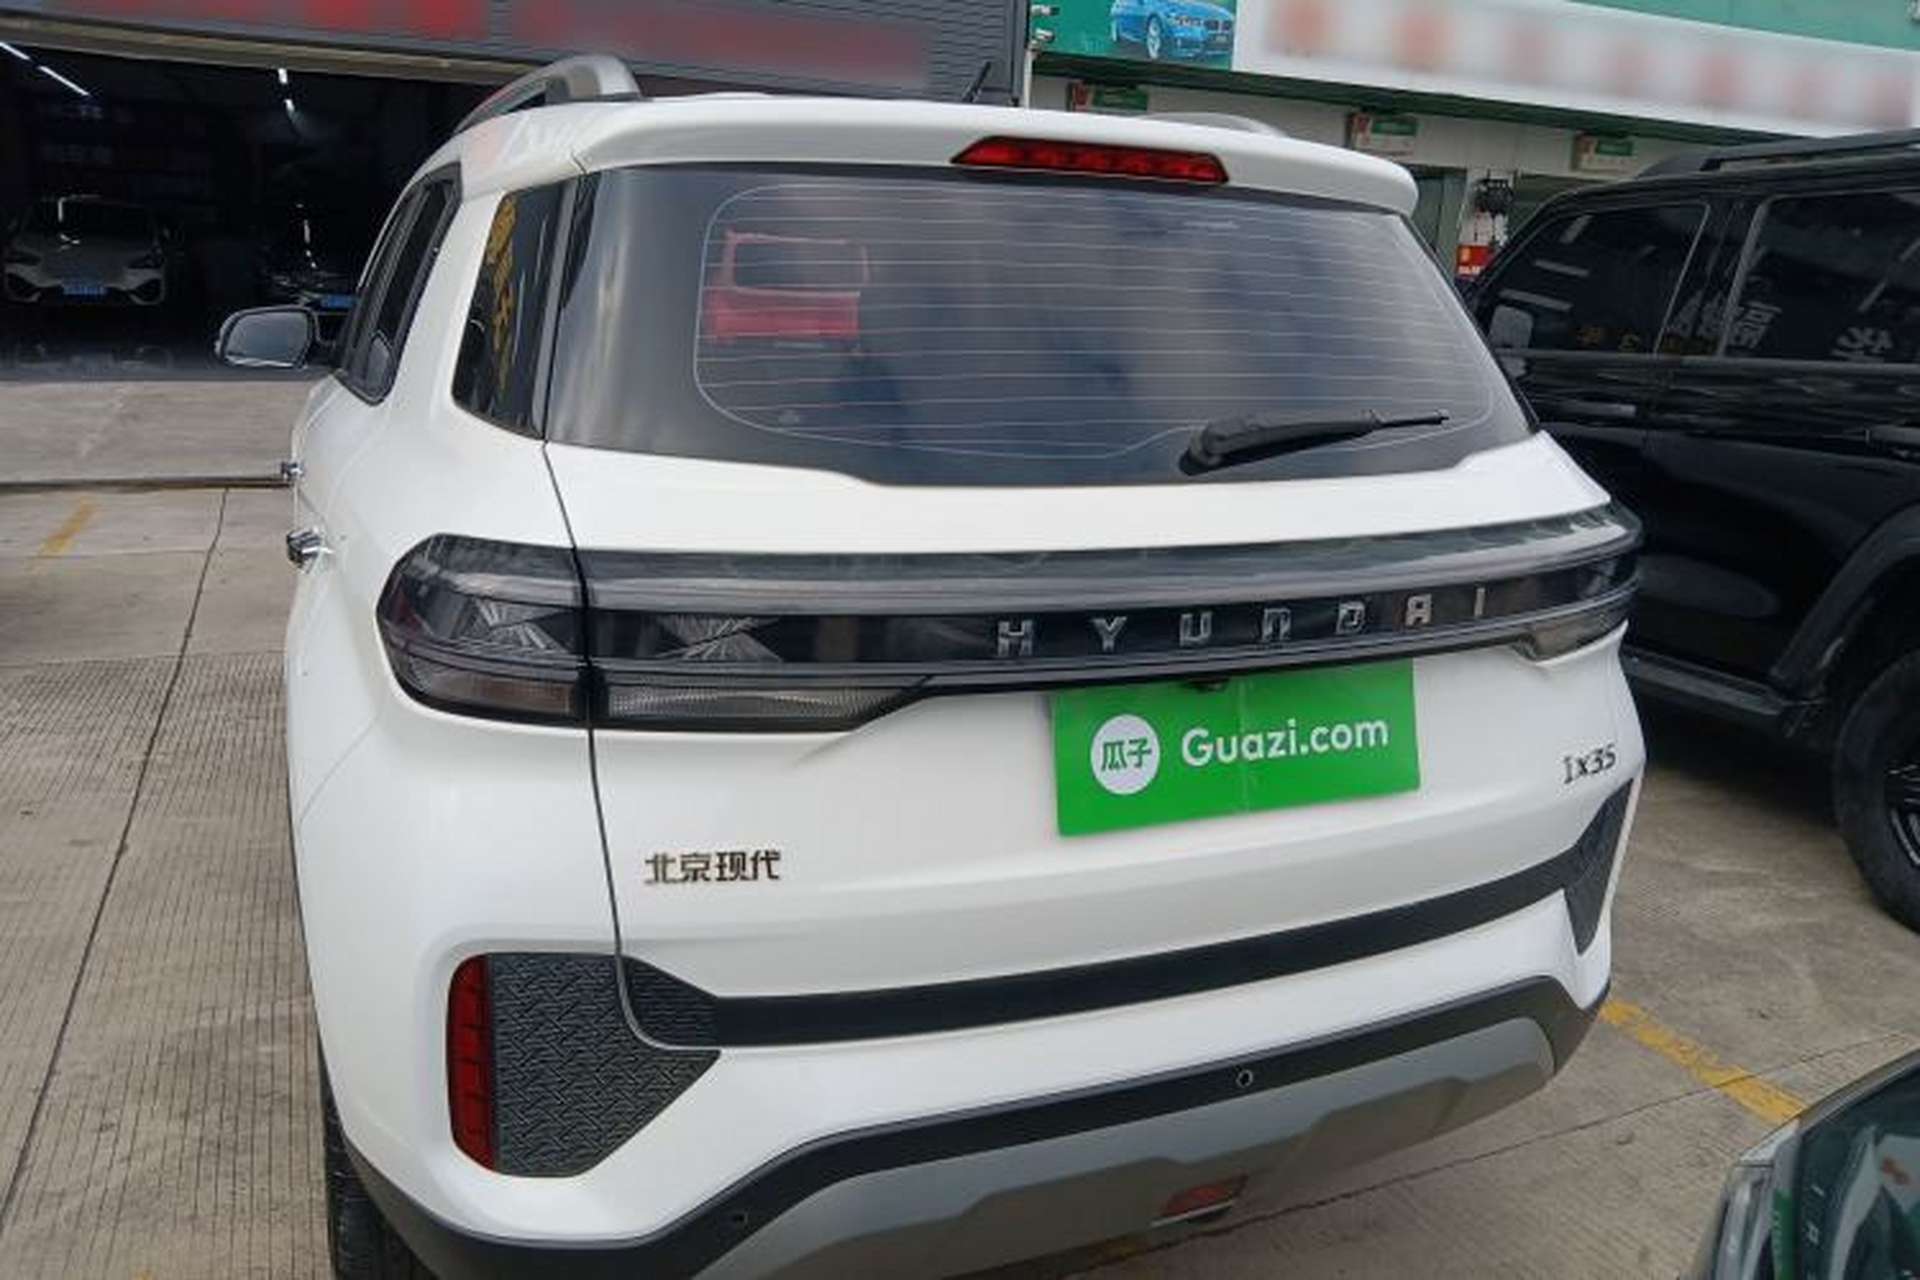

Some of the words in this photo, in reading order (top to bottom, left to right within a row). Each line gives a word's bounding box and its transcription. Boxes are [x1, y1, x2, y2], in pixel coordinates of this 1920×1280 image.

[997, 586, 1486, 657] HYUNDAI
[1100, 737, 1154, 772] 瓜子
[1181, 718, 1388, 767] Guazi.com
[644, 849, 781, 884] 北京现代
